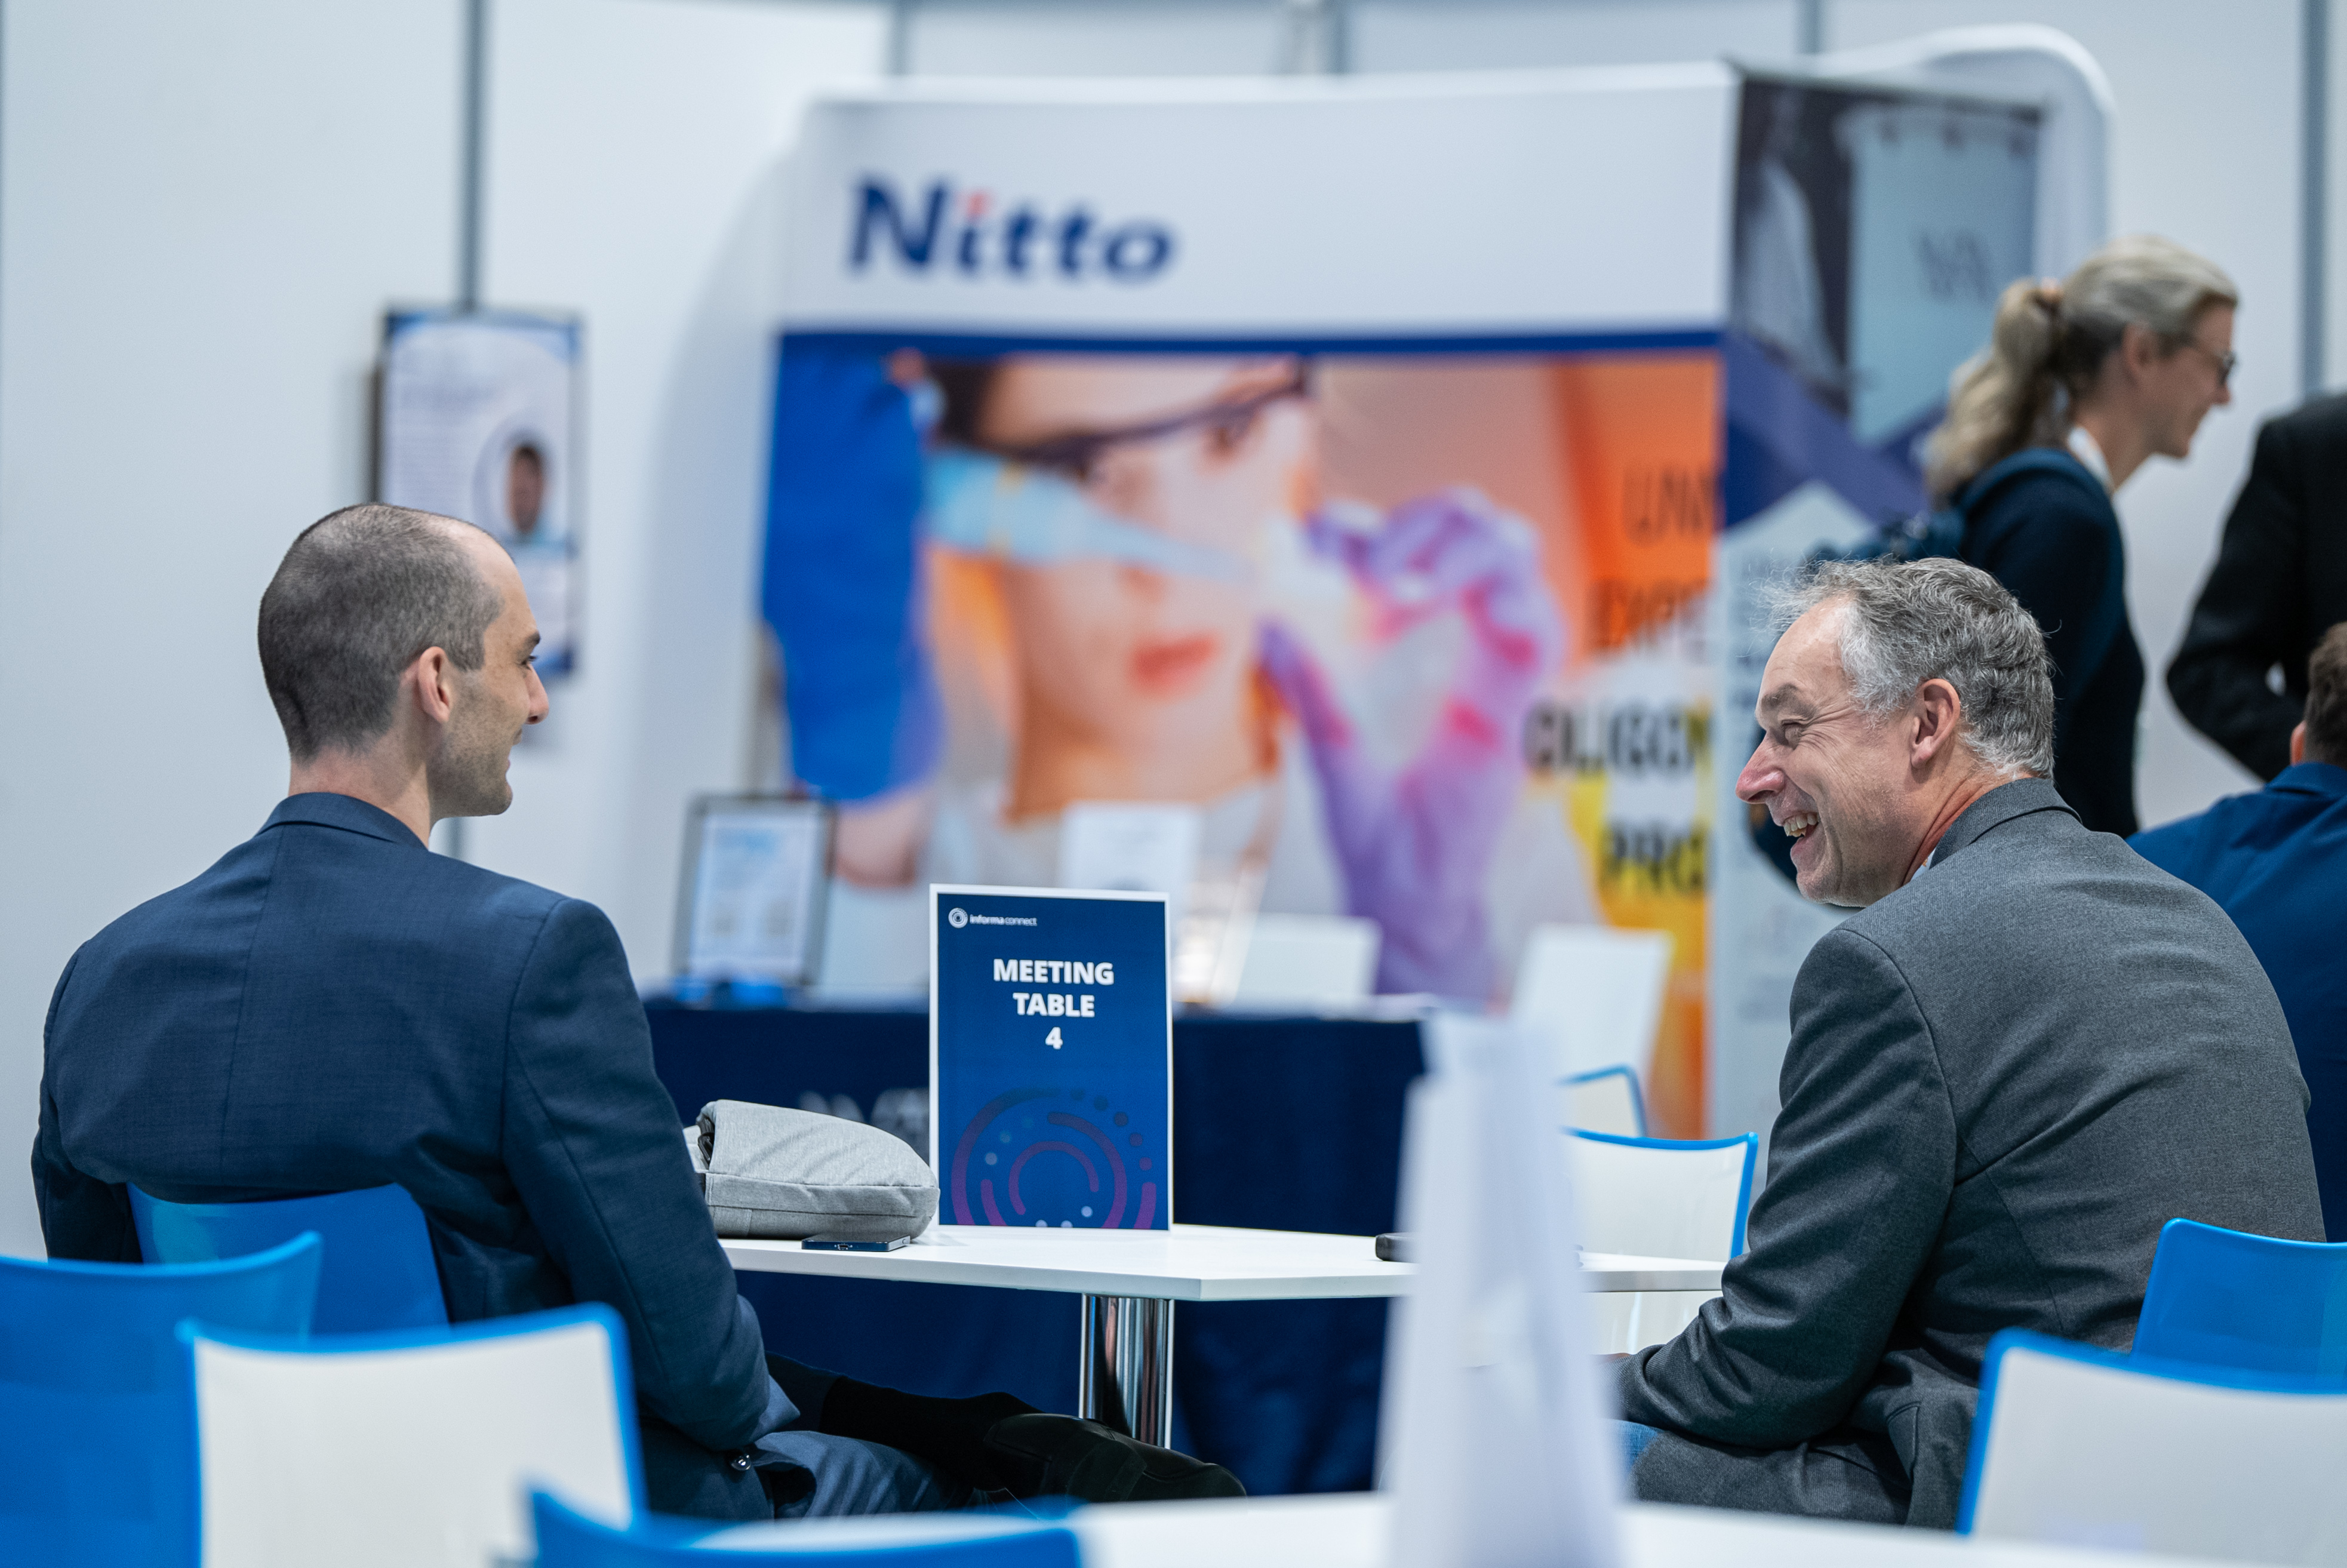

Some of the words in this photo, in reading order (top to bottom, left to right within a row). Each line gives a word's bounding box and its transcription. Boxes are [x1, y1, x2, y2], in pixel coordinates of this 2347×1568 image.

[849, 178, 1173, 283] Nitto
[970, 914, 1004, 925] informa
[1005, 917, 1038, 926] connect
[993, 958, 1115, 985] MEETING
[1013, 992, 1095, 1017] TABLE
[1045, 1027, 1063, 1050] 4
